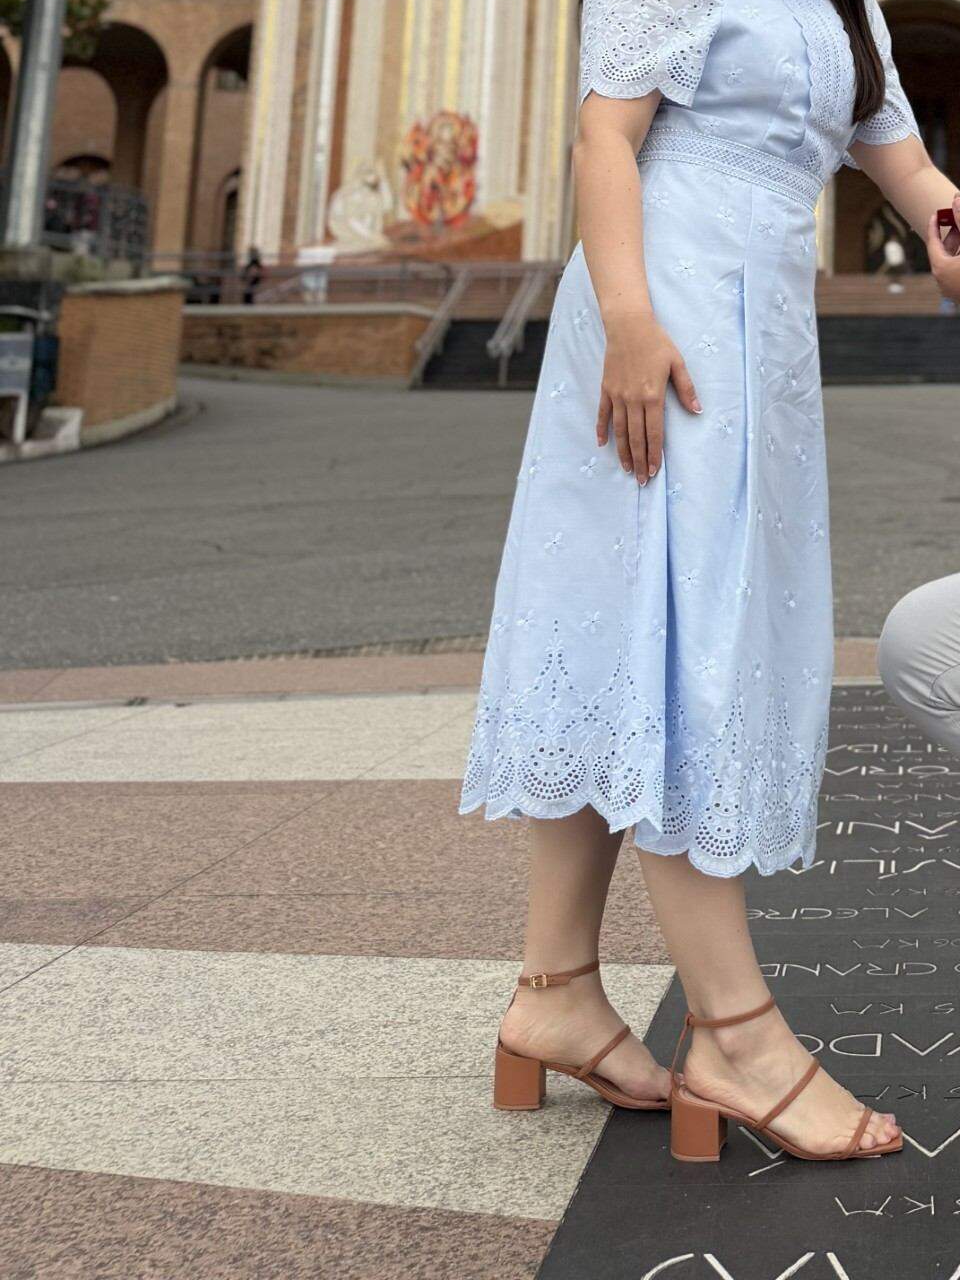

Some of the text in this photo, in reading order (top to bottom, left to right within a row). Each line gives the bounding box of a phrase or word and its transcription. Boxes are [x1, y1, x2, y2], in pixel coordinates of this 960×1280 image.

[866, 888, 926, 896] KM
[852, 938, 919, 949] KM
[758, 962, 937, 976] GRAND
[830, 1003, 904, 1015] KM
[833, 1195, 935, 1216] KM
